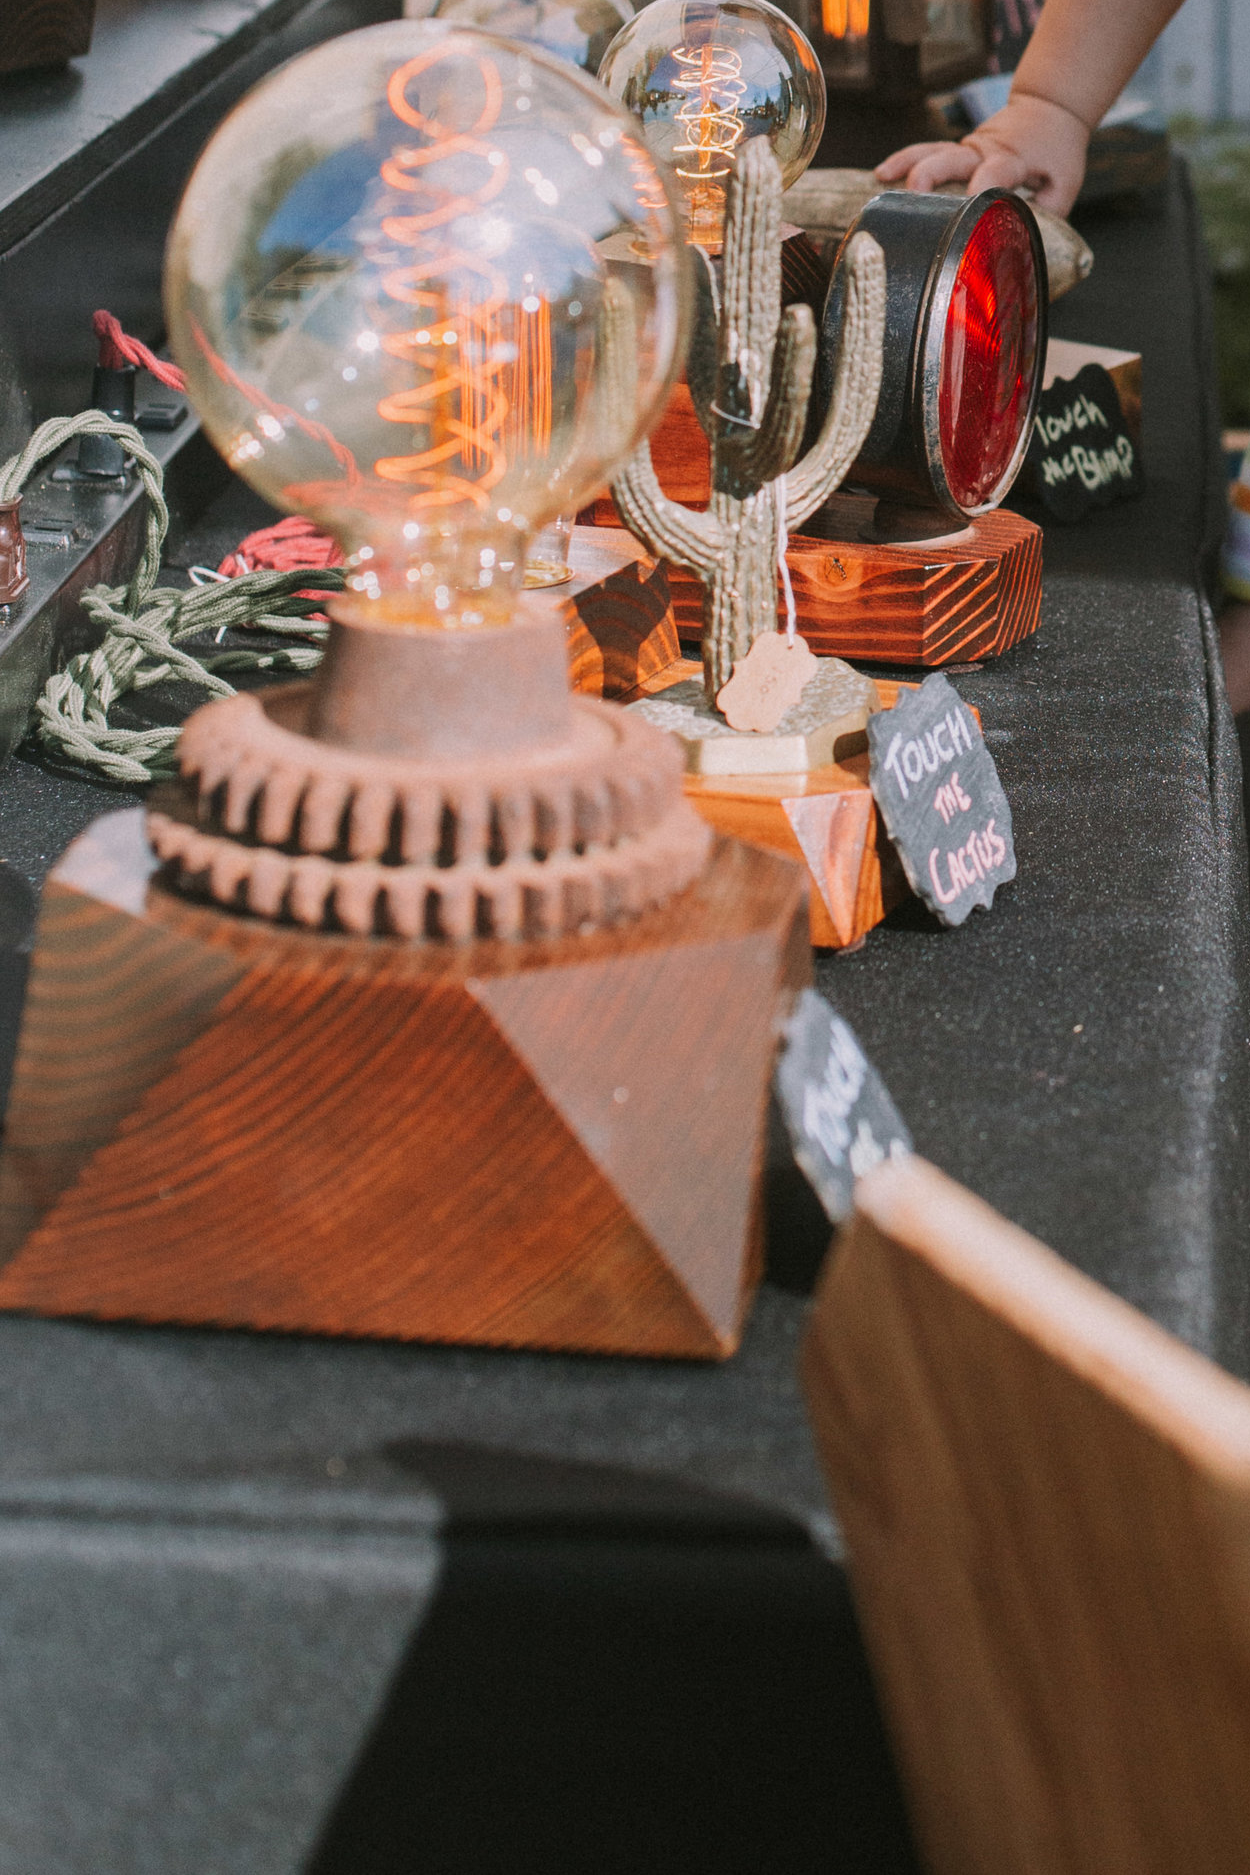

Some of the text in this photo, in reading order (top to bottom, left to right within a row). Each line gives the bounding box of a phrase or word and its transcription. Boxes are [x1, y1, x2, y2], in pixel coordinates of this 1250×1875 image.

[884, 706, 973, 800] TOUCH
[933, 771, 972, 825] THE
[929, 818, 1006, 904] CACTUS
